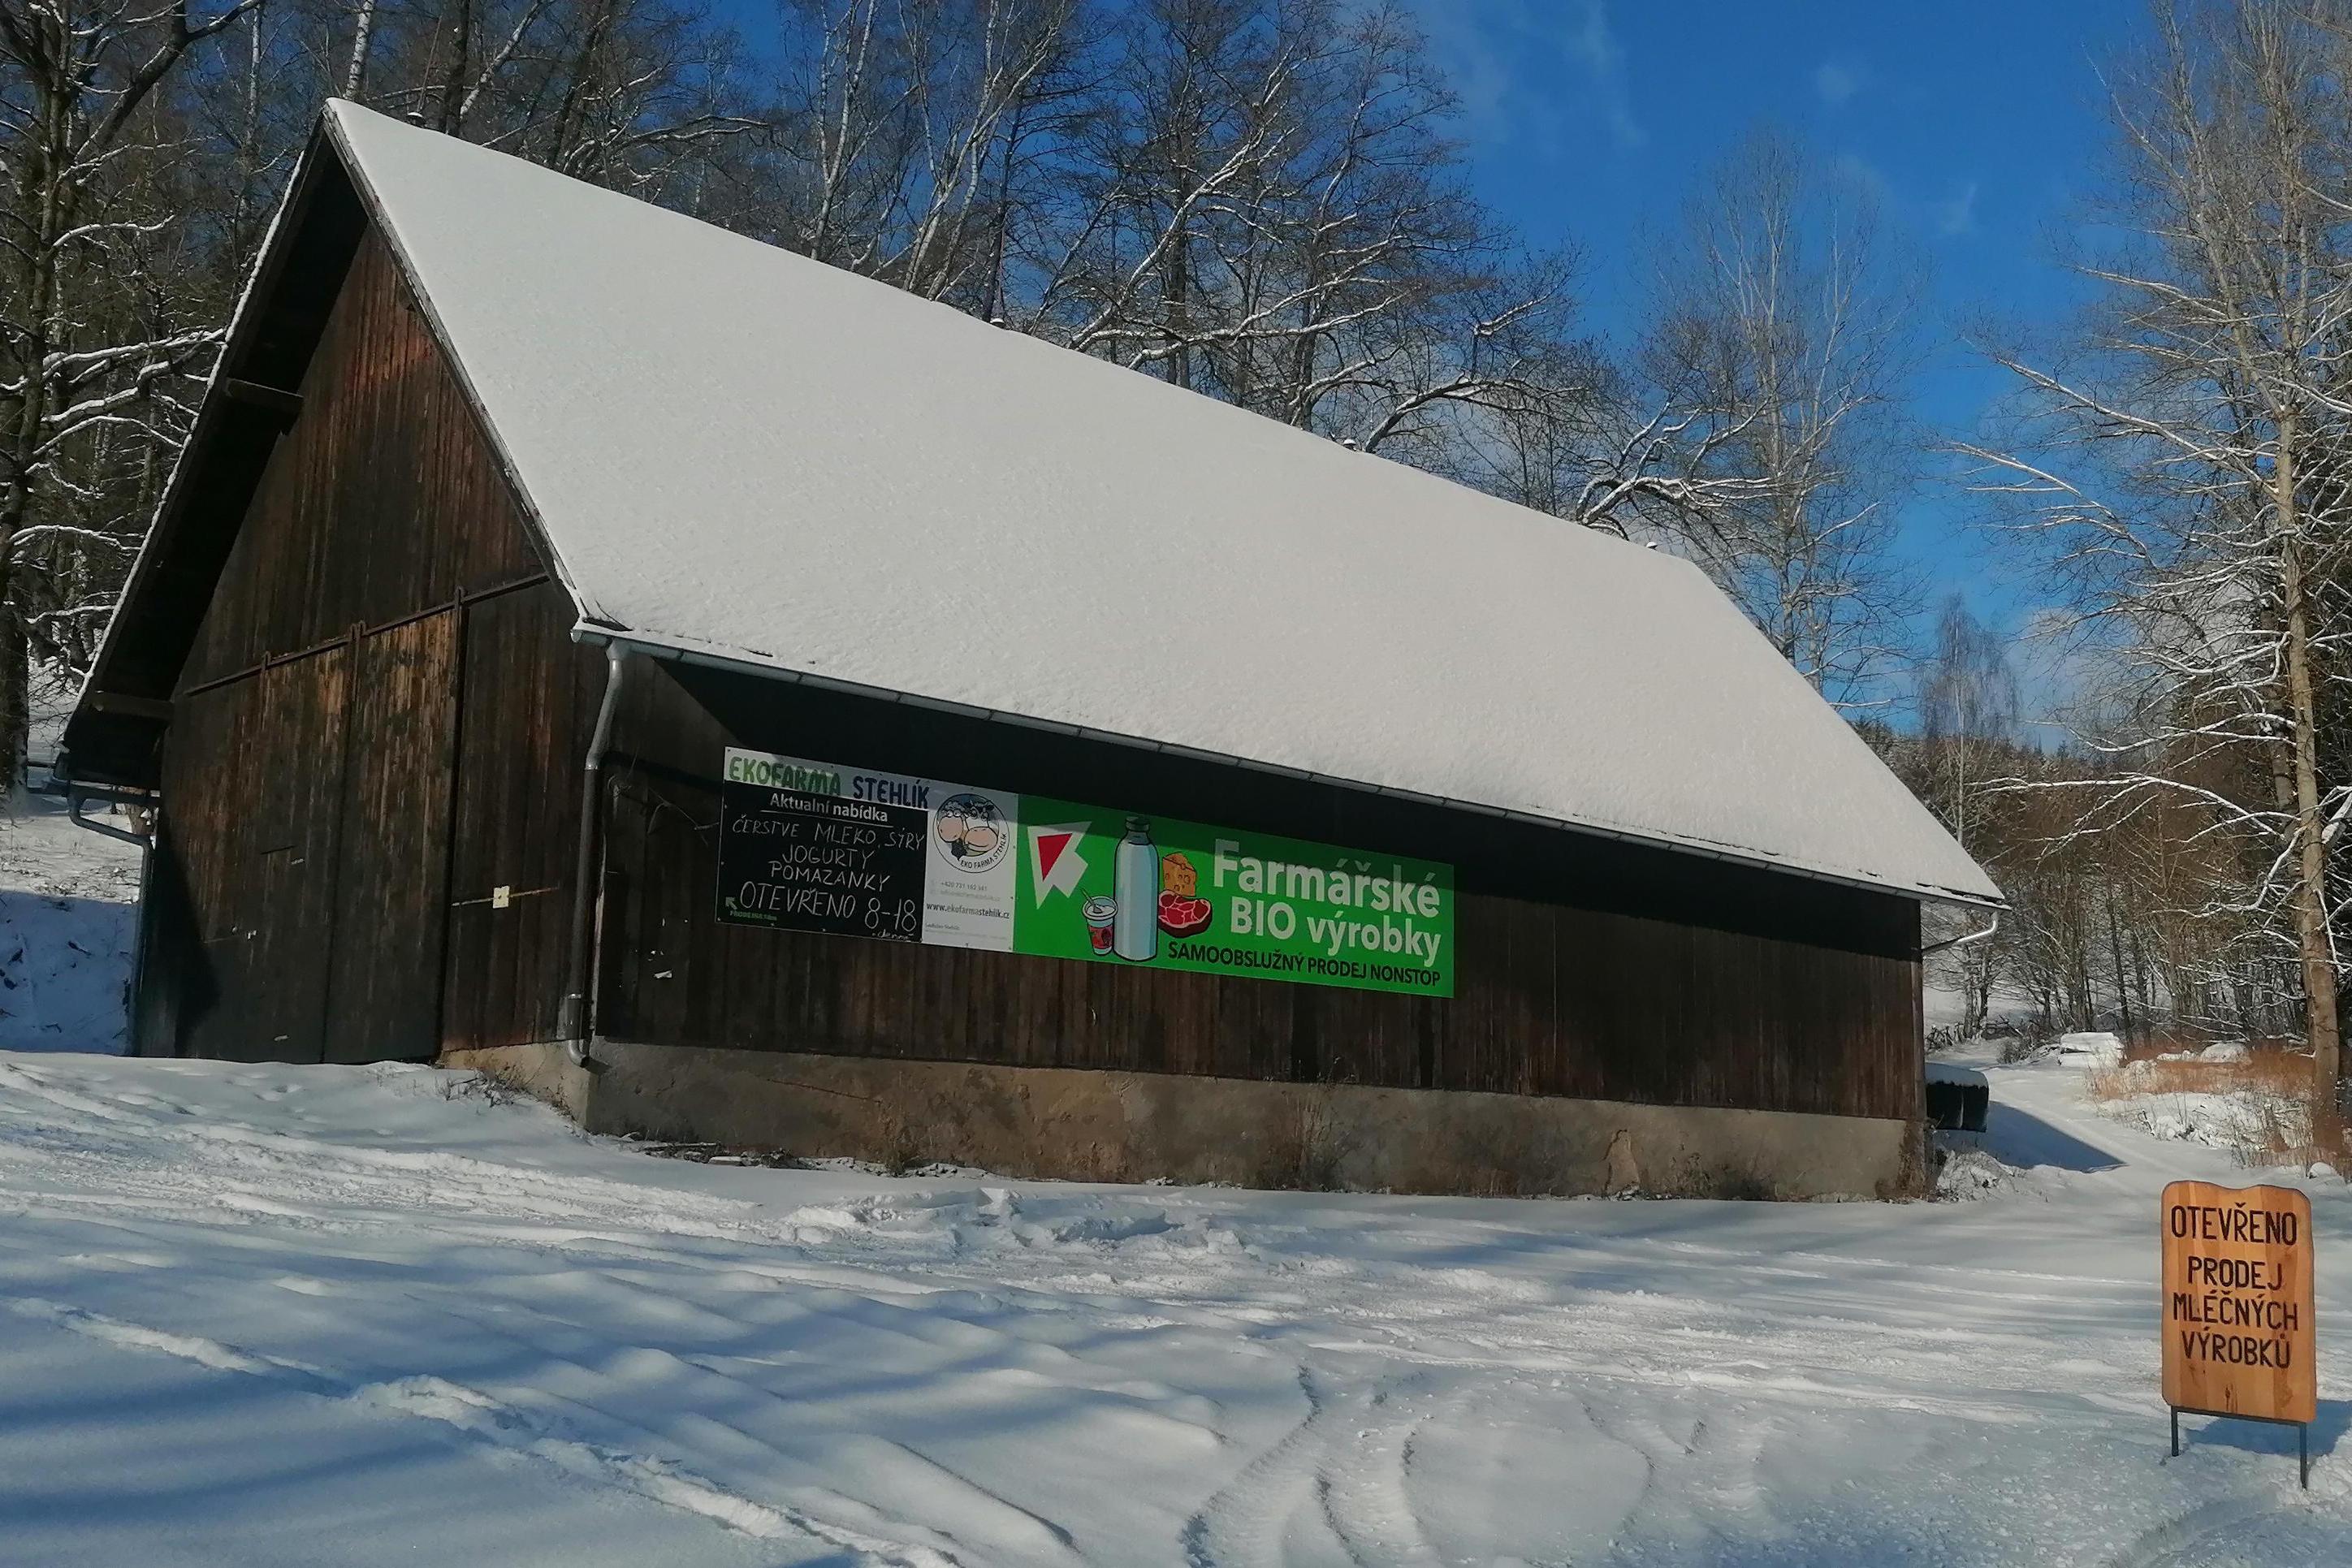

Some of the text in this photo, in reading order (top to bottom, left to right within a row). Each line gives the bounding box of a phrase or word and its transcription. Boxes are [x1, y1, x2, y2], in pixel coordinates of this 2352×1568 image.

[729, 756, 930, 809] EKOFARMA STEHLÍK
[832, 803, 888, 823] nabídka
[781, 844, 875, 869] JOGURTY
[961, 860, 973, 869] EKO
[974, 857, 995, 868] FARMA
[740, 881, 856, 918] OTEVŘENO
[1213, 839, 1441, 918] Farmářské
[1230, 896, 1442, 968] BIO výrobky
[1168, 940, 1442, 987] SAMOOBSLUŽNÝ PRODEJ NONSTOP
[2171, 1202, 2298, 1246] OTEVŘENO
[2188, 1256, 2283, 1291] PRODEJ
[2173, 1289, 2298, 1331] MLÉČNÝCH
[2181, 1326, 2290, 1369] VÝROBKŮ
